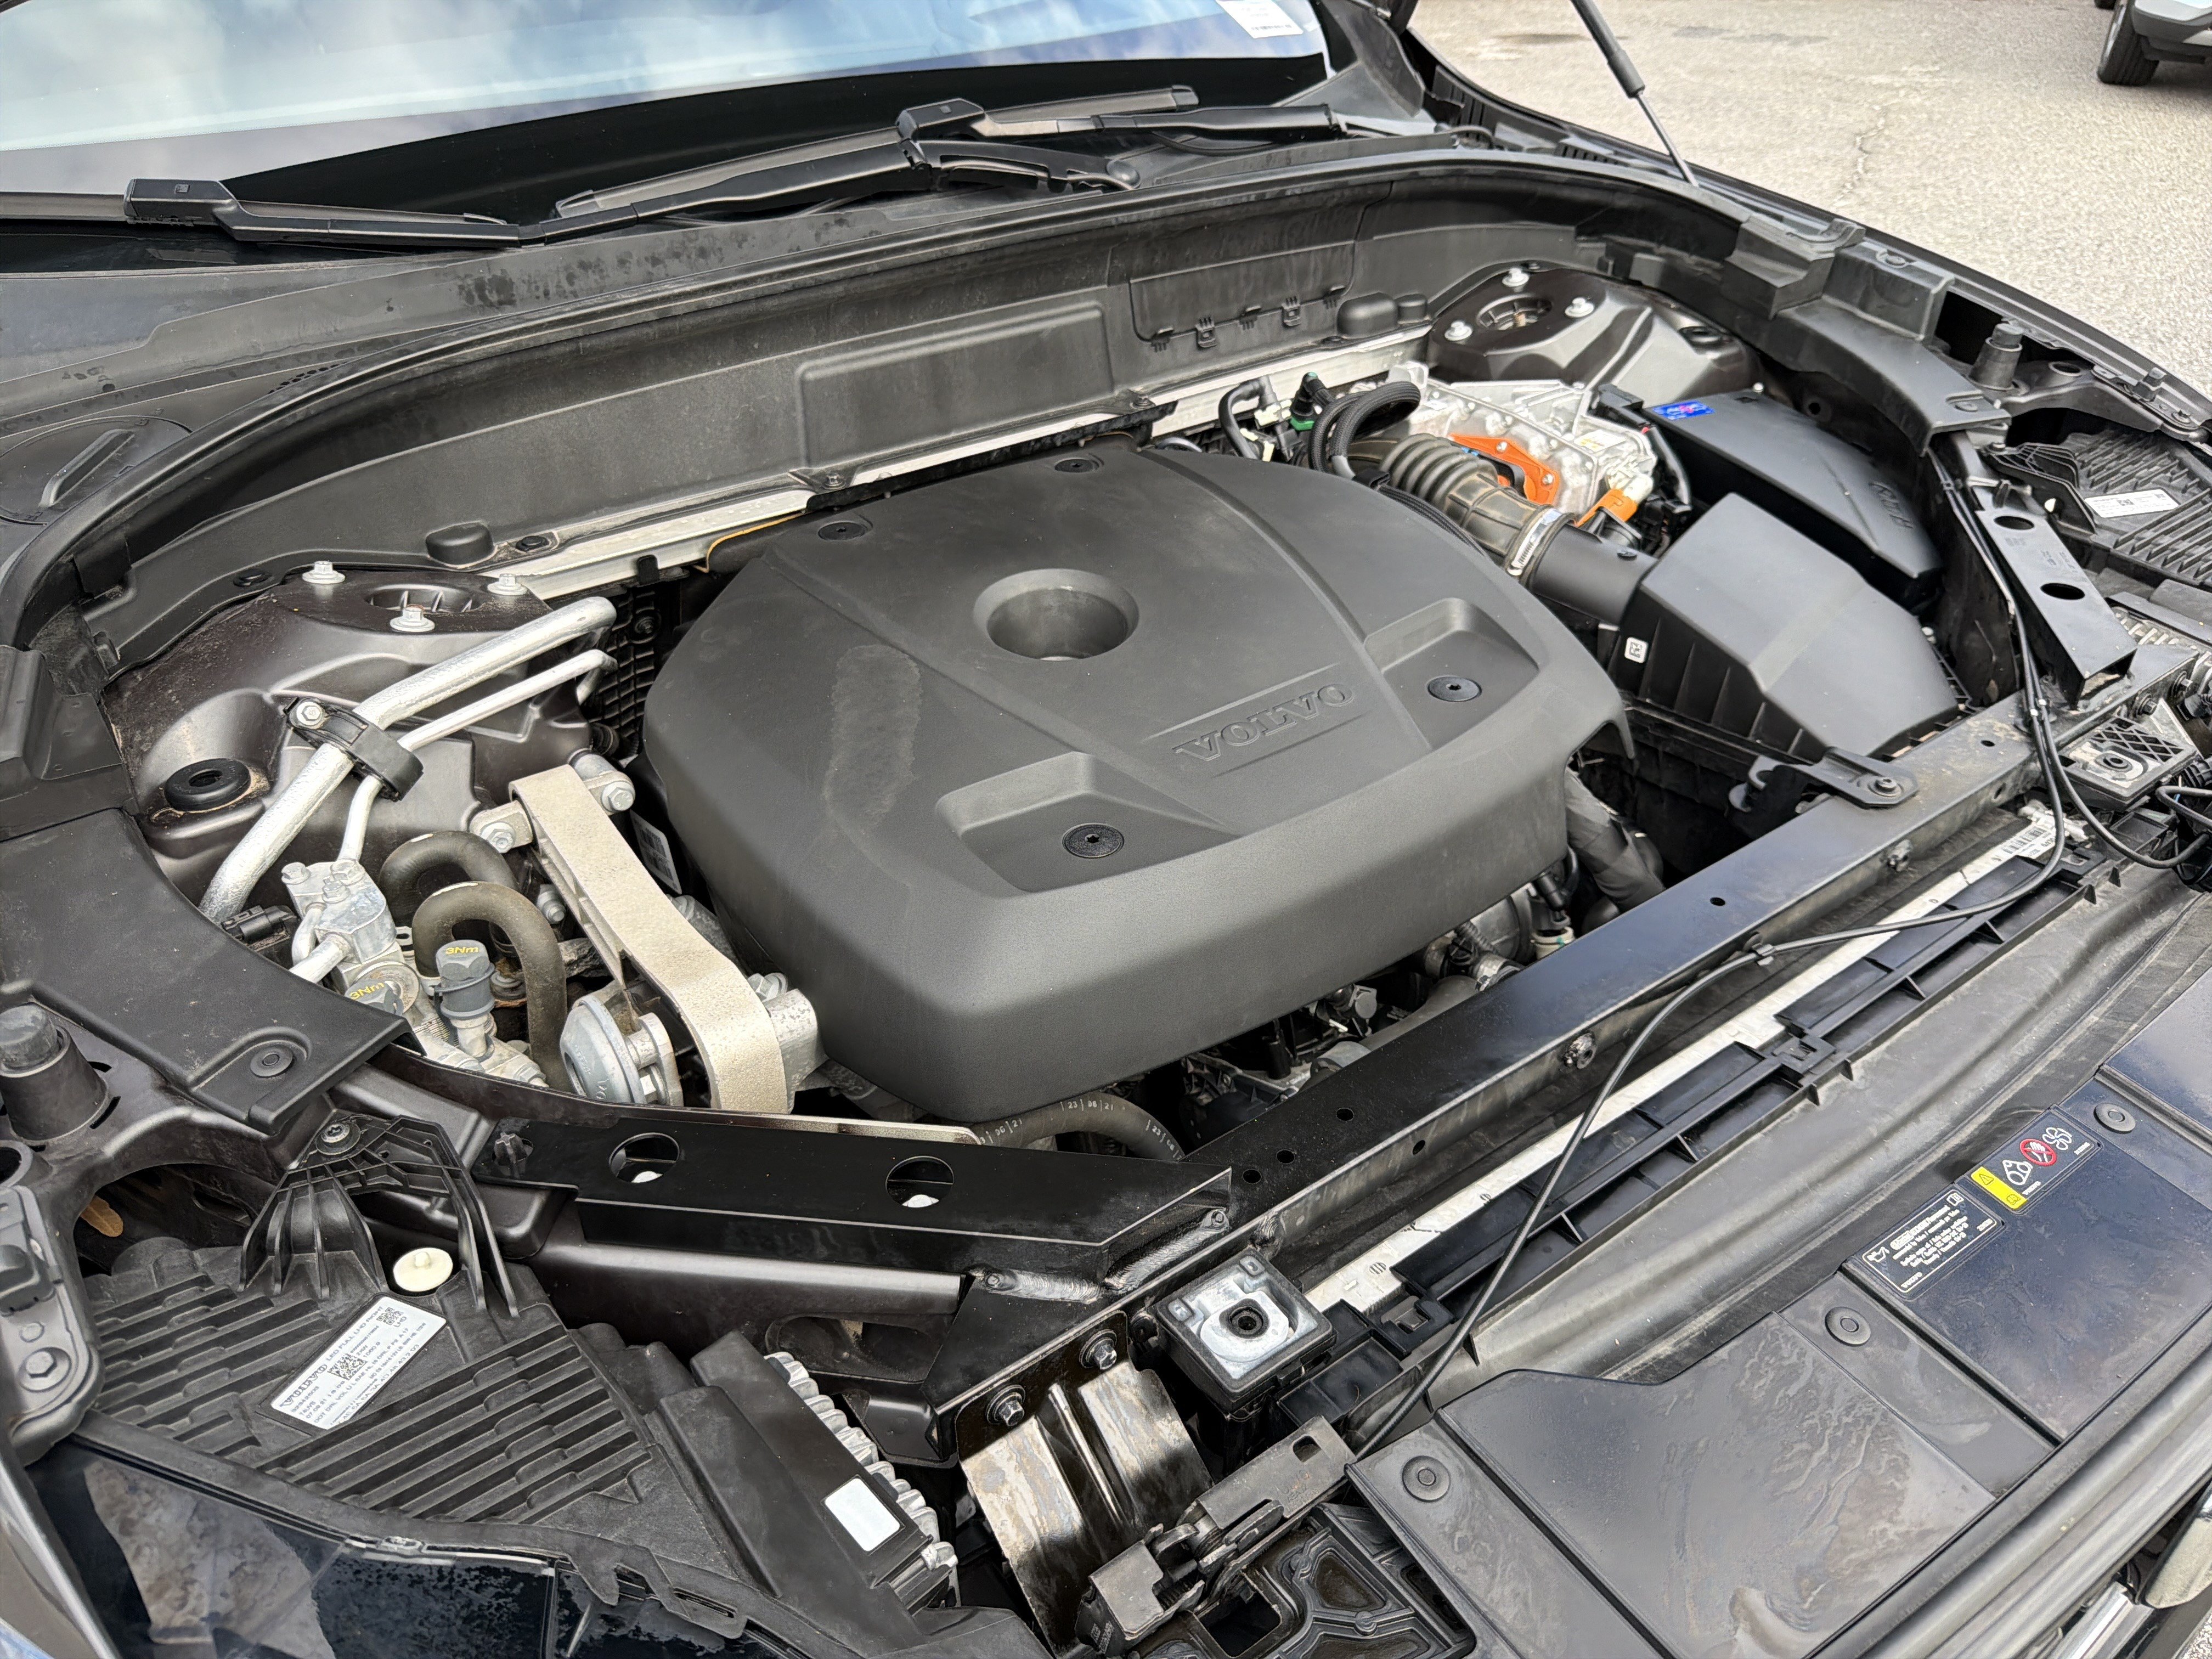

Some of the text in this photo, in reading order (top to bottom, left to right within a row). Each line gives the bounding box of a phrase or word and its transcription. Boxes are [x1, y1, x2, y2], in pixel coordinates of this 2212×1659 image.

[1172, 684, 1354, 761] VOLVO
[349, 983, 385, 1000] 3Nm
[2021, 1180, 2042, 1196] VOLVO
[279, 1363, 329, 1409] VOLVO
